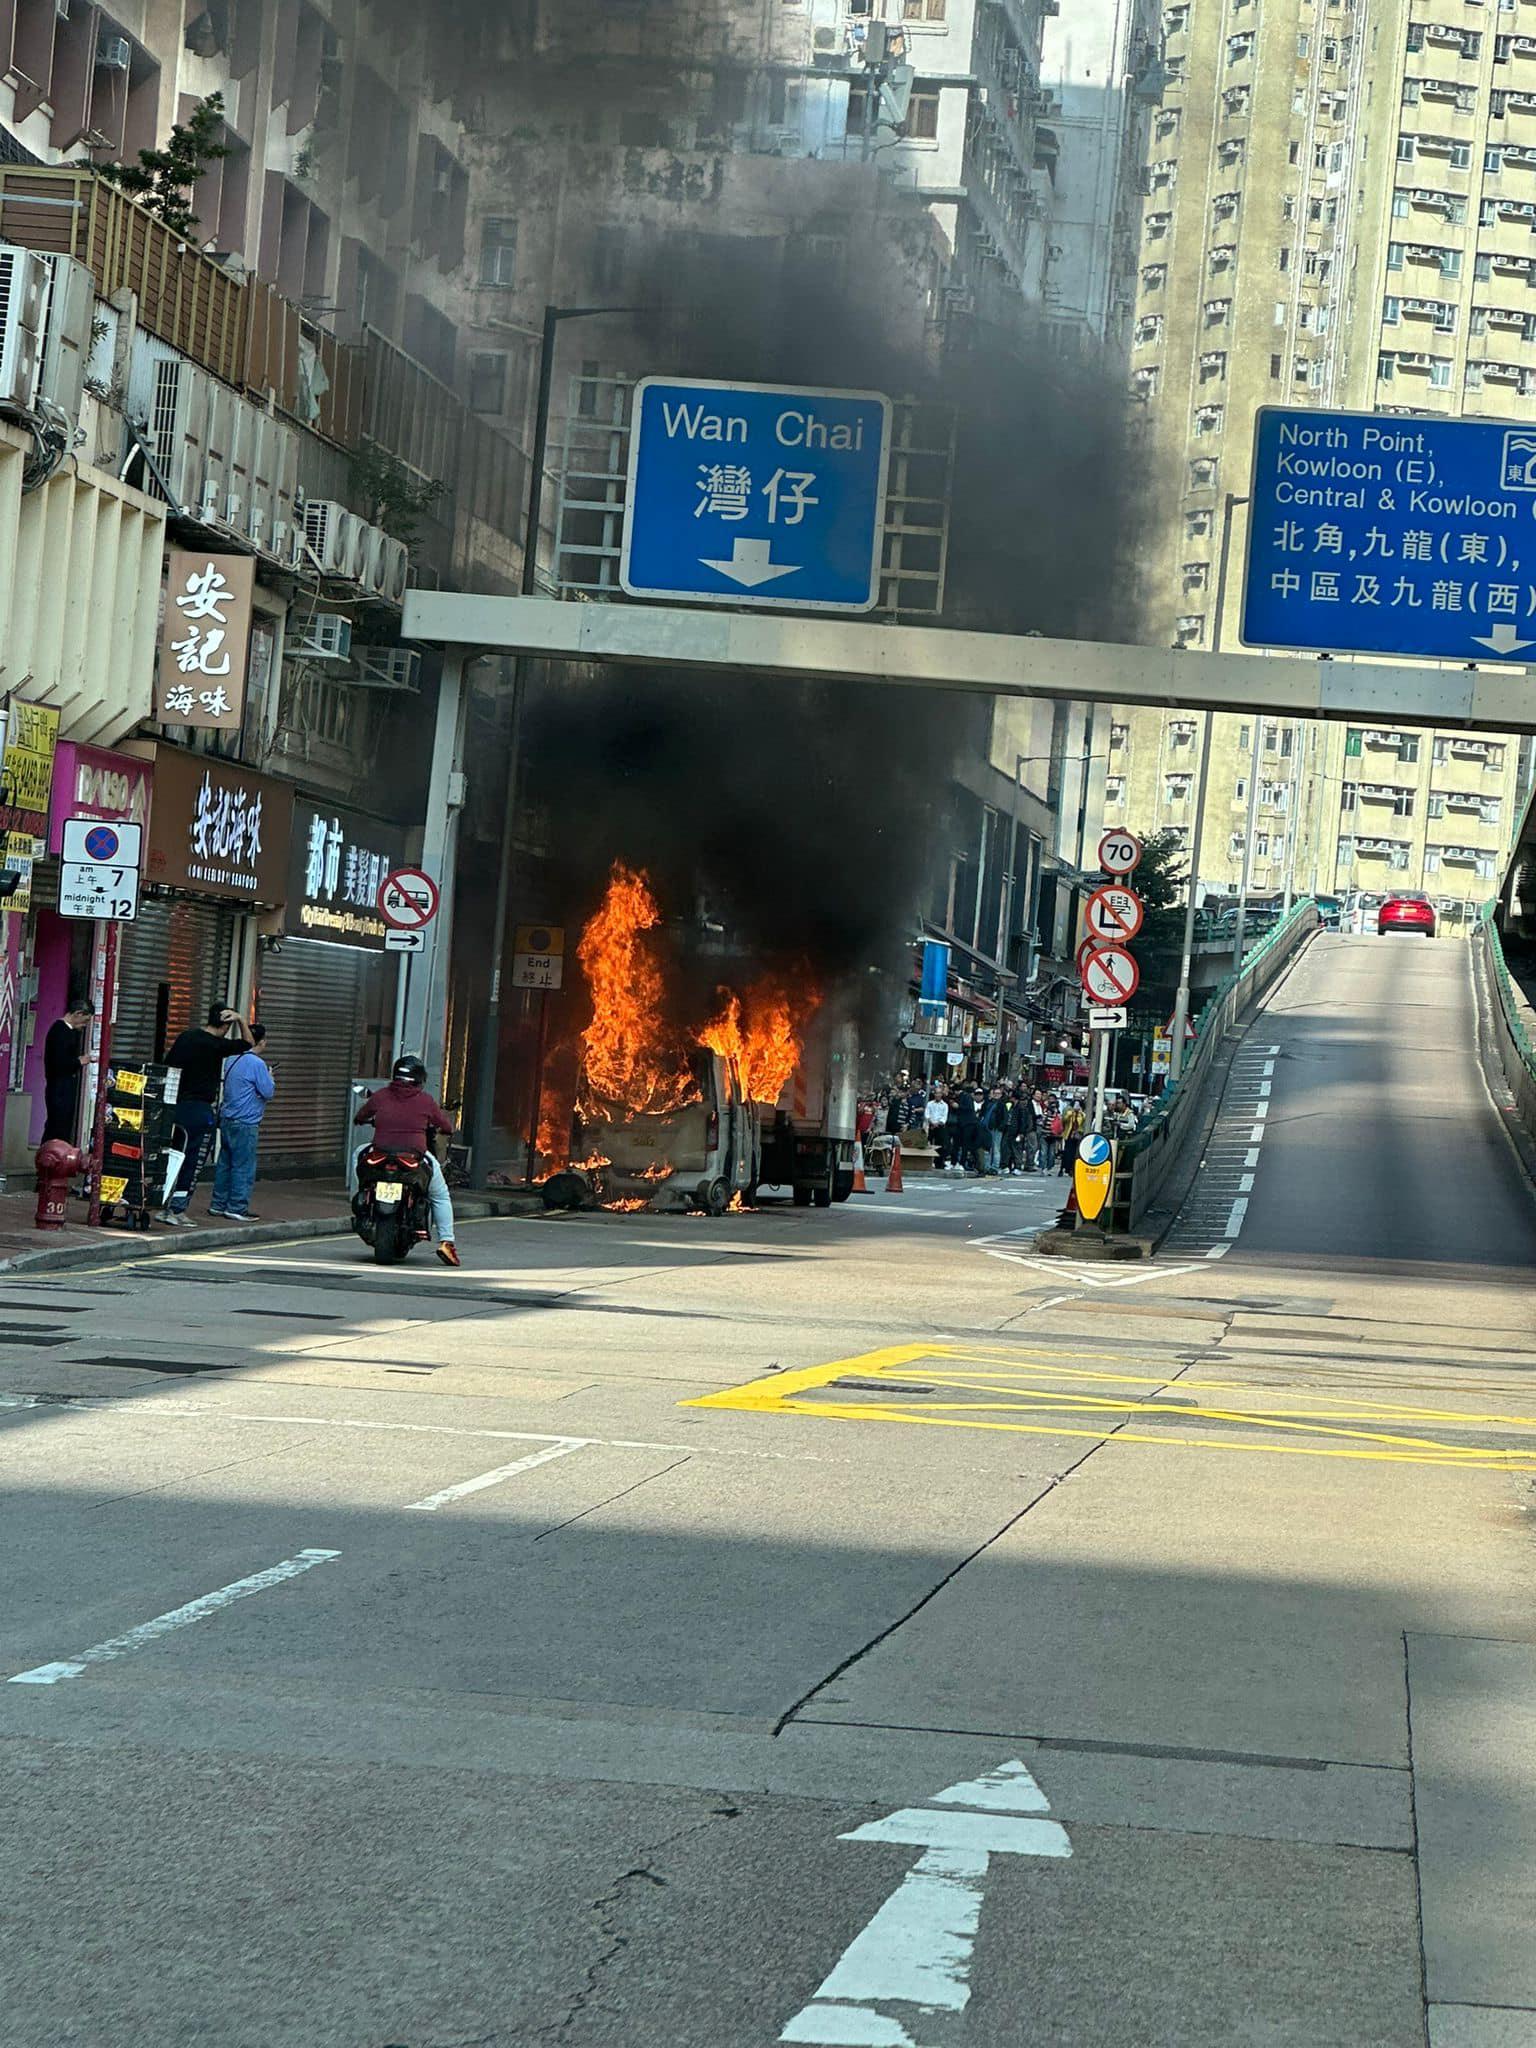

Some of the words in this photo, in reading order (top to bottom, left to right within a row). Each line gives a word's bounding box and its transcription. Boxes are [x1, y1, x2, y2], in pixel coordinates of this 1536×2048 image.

[662, 401, 747, 443] Wan
[775, 410, 863, 450] Chai
[1279, 423, 1348, 449] North
[1362, 428, 1433, 457] Point,
[1276, 452, 1382, 481] Kowloon
[1395, 460, 1444, 488] (E),
[1507, 464, 1524, 482] 東
[693, 463, 819, 525] 灣仔
[1275, 482, 1365, 509] Central
[1378, 489, 1396, 511] &
[1410, 490, 1517, 519] Kowloon
[171, 561, 236, 676] 安記
[164, 684, 232, 717] 海味
[1107, 844, 1133, 861] 70
[74, 875, 97, 885] 上午
[111, 870, 124, 887] 7
[64, 893, 106, 905] midnight
[72, 904, 96, 915] 午夜
[110, 899, 132, 918] 12
[527, 957, 550, 968] End
[46, 1201, 64, 1215] 30
